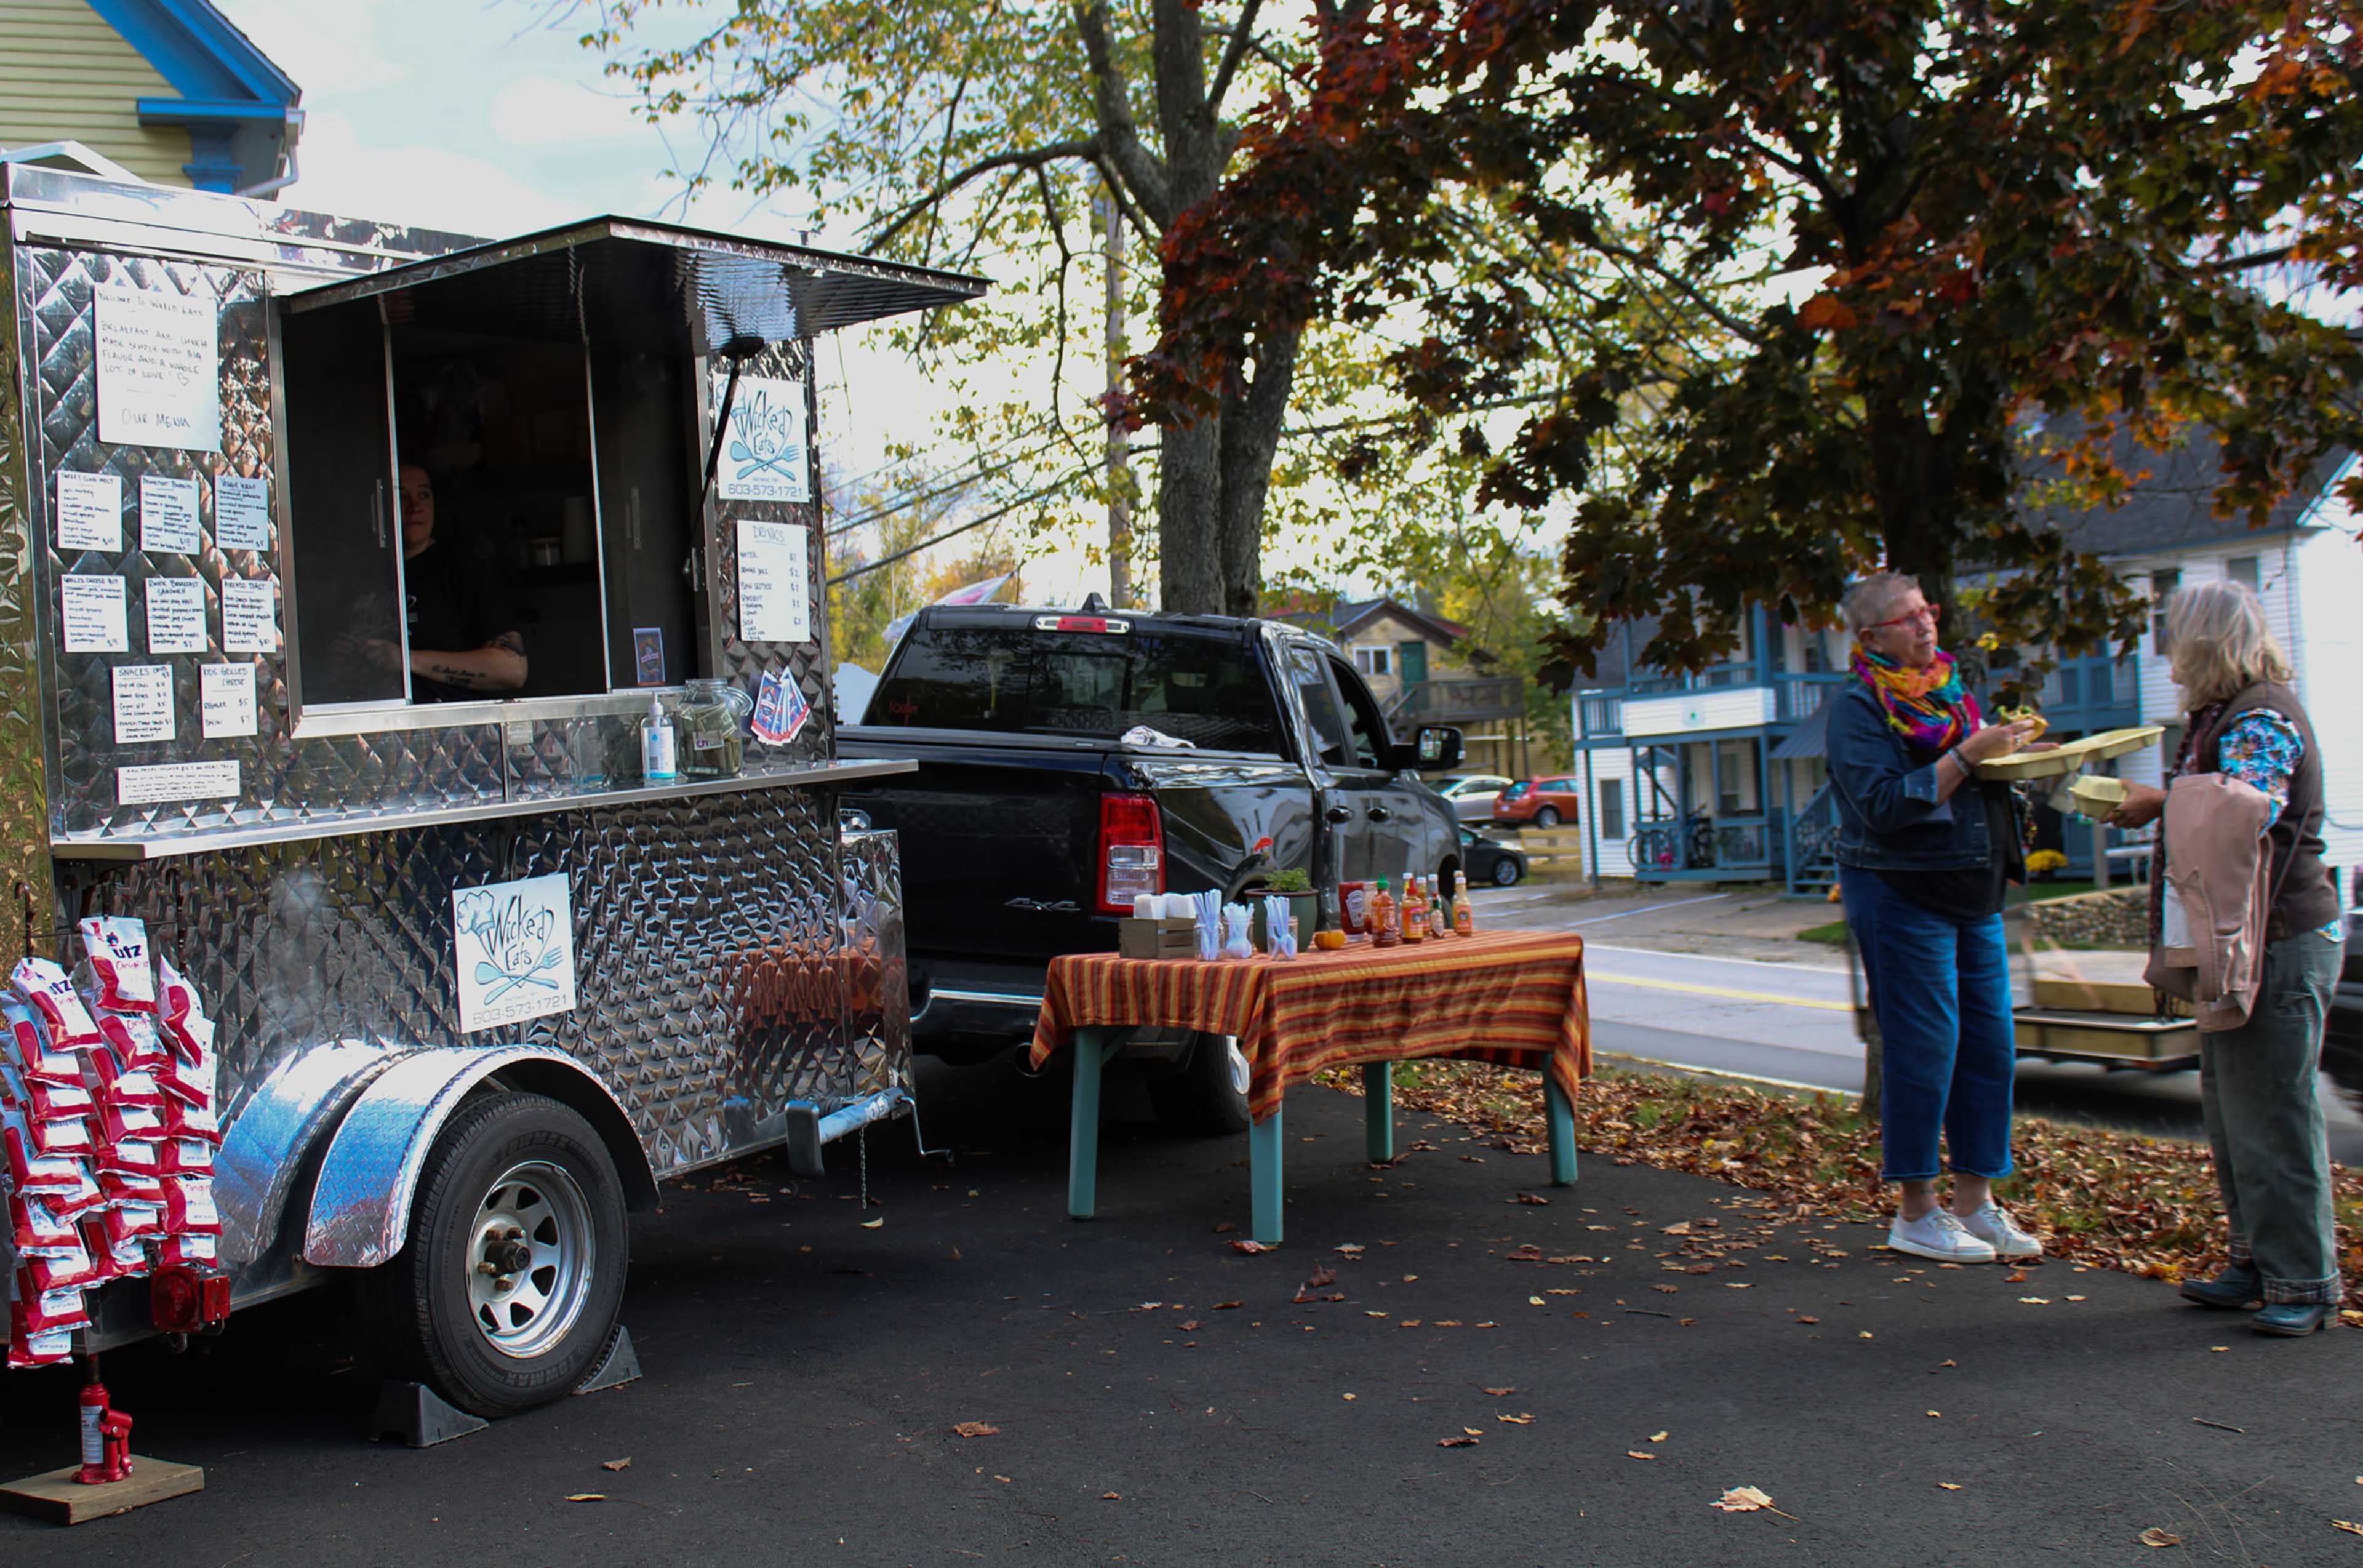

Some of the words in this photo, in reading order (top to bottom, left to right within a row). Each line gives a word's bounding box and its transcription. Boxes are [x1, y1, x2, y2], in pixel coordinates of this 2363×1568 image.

[754, 432, 775, 457] Eats
[753, 525, 786, 542] DRINKS
[487, 894, 545, 956] Wicked
[506, 942, 532, 971] Eats
